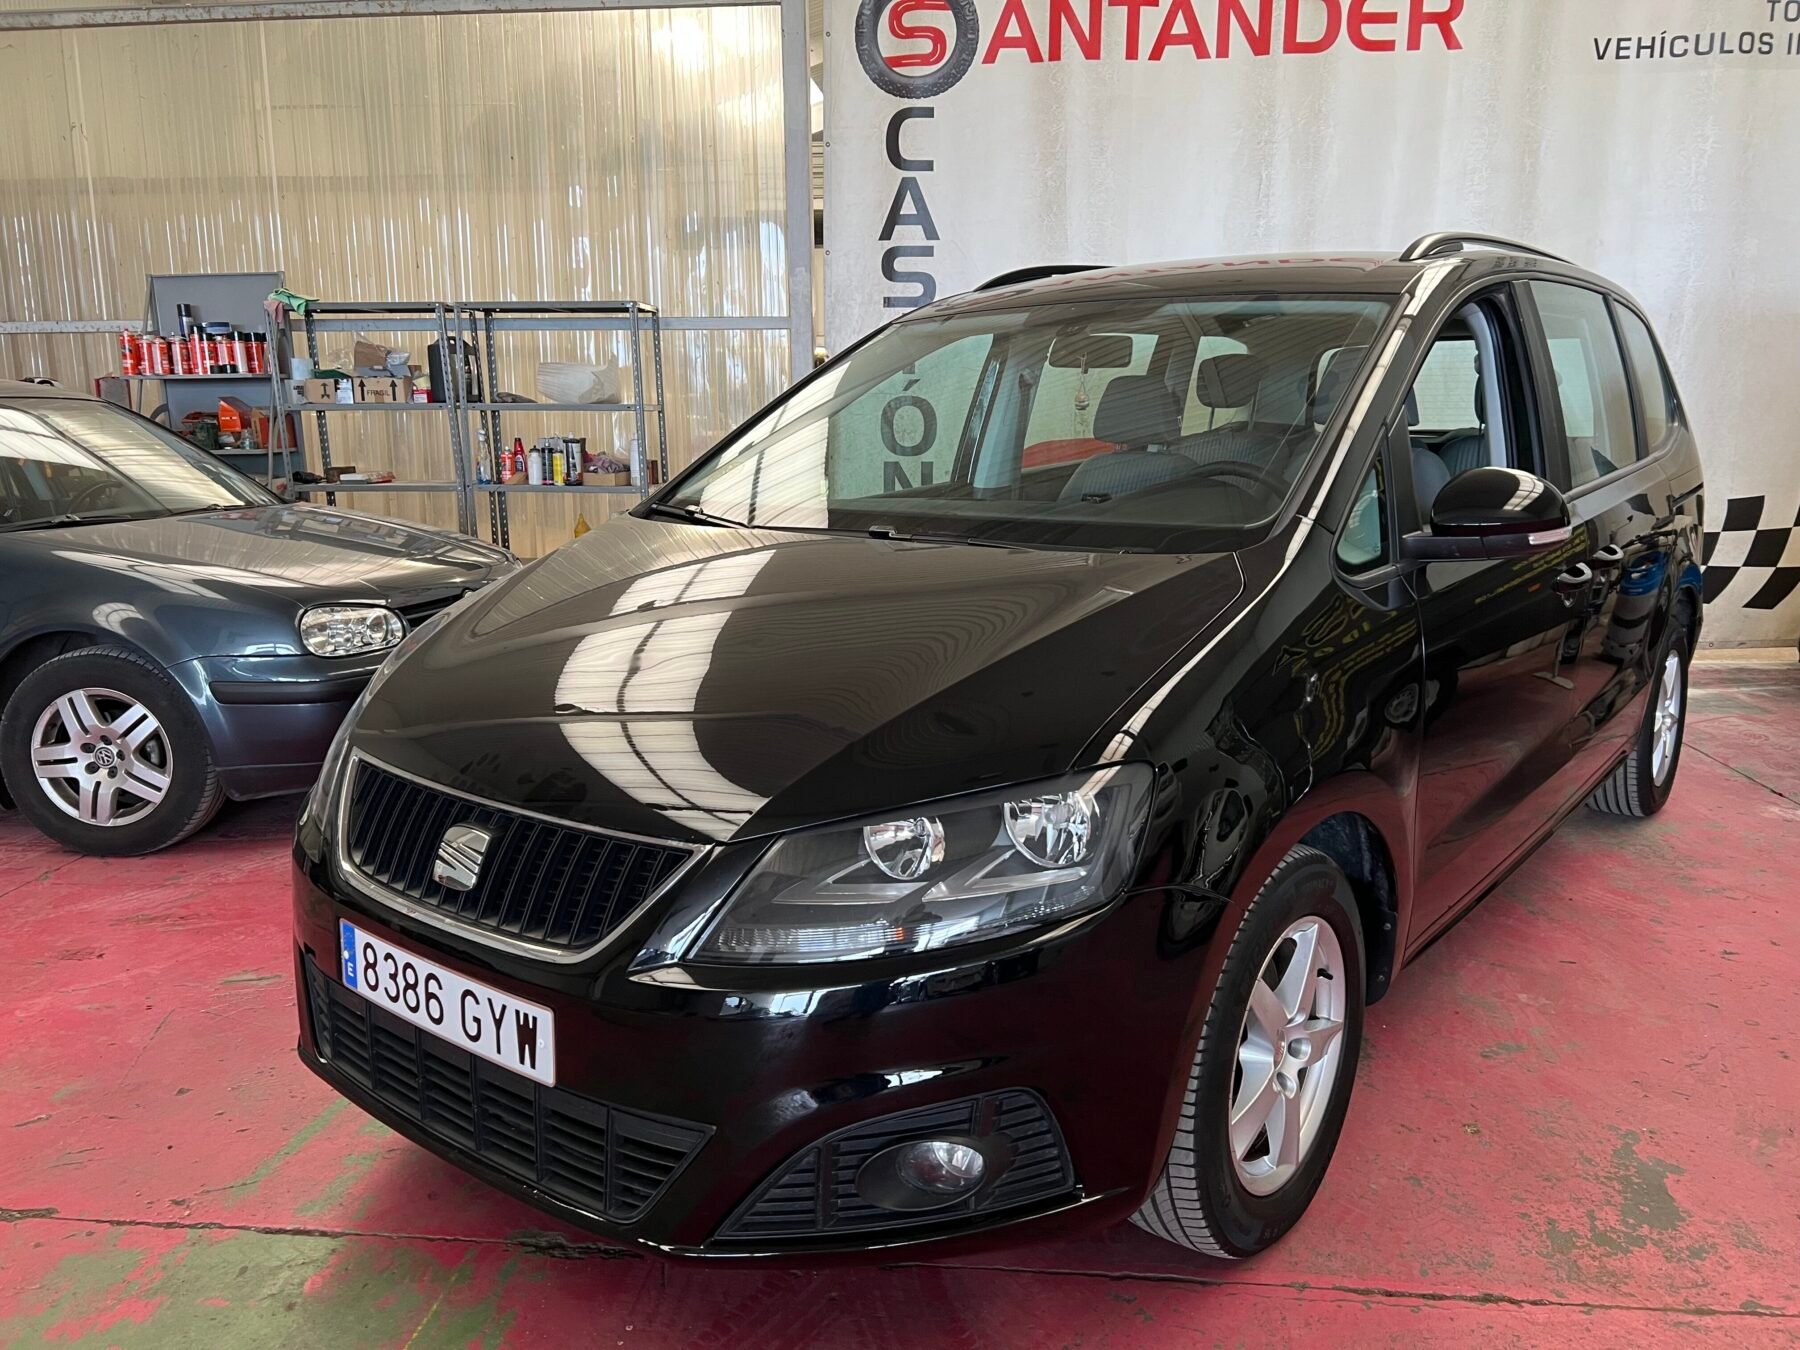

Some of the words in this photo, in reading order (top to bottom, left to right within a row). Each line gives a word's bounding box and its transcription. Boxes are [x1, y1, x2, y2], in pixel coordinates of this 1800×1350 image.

[1593, 30, 1774, 60] VEHÍCULOS
[362, 941, 444, 1026] 8386
[460, 988, 538, 1071] GYW
